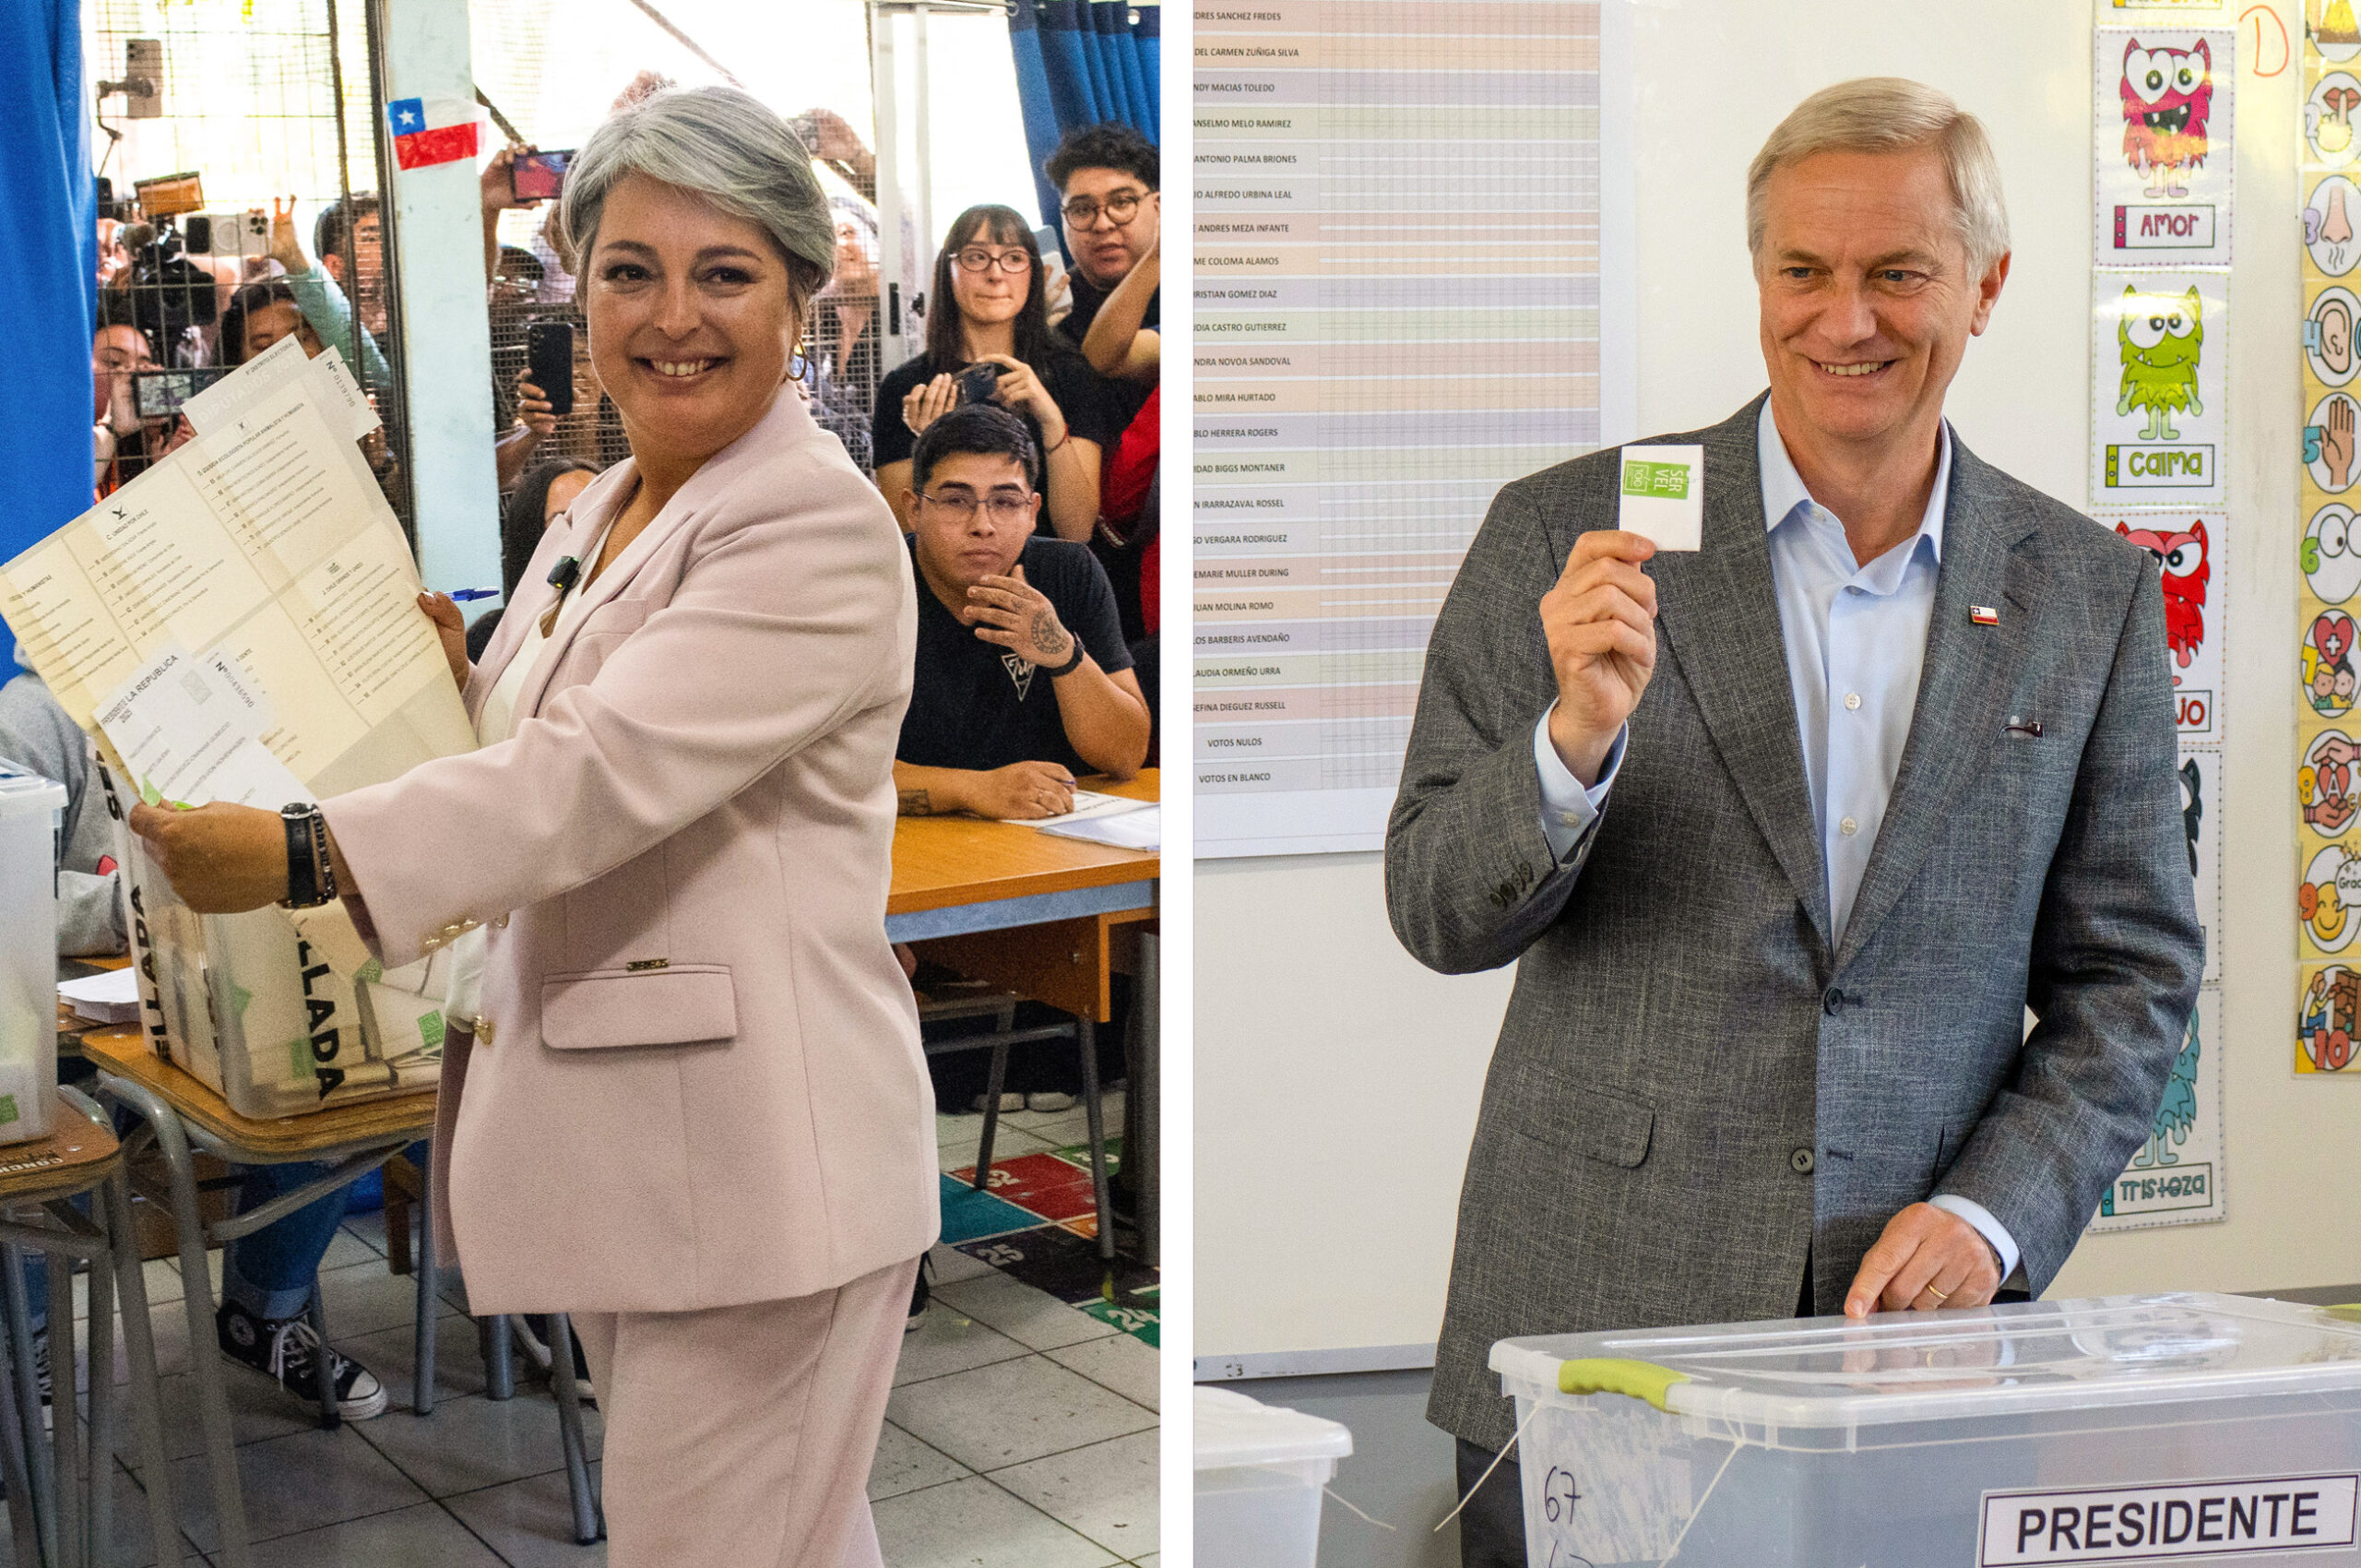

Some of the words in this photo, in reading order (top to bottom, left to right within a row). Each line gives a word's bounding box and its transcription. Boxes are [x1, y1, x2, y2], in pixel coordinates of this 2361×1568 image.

[1216, 12, 1252, 20] SANCHEZ
[1253, 12, 1282, 20] FREDES
[1194, 48, 1208, 56] DEL
[1210, 48, 1244, 56] CARMEN
[1246, 47, 1275, 56] ZUÑIGA
[1277, 49, 1299, 57] SILVA
[1211, 84, 1242, 92] MACIAS
[1244, 84, 1275, 92] TOLEDO
[1231, 120, 1254, 128] MELO
[1256, 120, 1291, 128] RAMIREZ
[1194, 155, 1231, 163] ANTONIO
[1233, 155, 1262, 163] PALMA
[1264, 155, 1297, 163] BRIONES
[1204, 191, 1240, 199] ALFREDO
[1242, 191, 1273, 199] URBINA
[1275, 191, 1292, 199] LEAL
[1199, 224, 1230, 232] ANDRES
[1232, 224, 1254, 232] MEZA
[1256, 224, 1289, 232] INFANTE
[2303, 208, 2321, 246] 3
[1208, 257, 1243, 266] COLOMA
[1246, 257, 1279, 266] ALAMOS
[1228, 291, 1257, 299] GOMEZ
[1212, 324, 1242, 332] CASTRO
[1244, 324, 1287, 332] GUTIERREZ
[2303, 319, 2322, 358] 4
[1218, 358, 1248, 366] NOVOA
[1250, 357, 1291, 365] SANDOVAL
[1215, 394, 1236, 402] MIRA
[1238, 394, 1275, 402] HURTADO
[1248, 429, 1278, 437] ROGERS
[2303, 426, 2320, 464] 5
[1240, 464, 1285, 472] MONTANER
[2129, 451, 2202, 477] Calma
[1654, 469, 1669, 491] VEL
[1668, 469, 1684, 492] SER
[1202, 500, 1254, 508] IRARRAZAVAL
[1256, 500, 1285, 508] ROSSEL
[1204, 536, 1241, 544] VERGARA
[1243, 534, 1287, 542] RODRIGUEZ
[2300, 536, 2320, 576] 6
[1226, 570, 1257, 578] MULLER
[1259, 568, 1289, 577] DURING
[1216, 603, 1247, 612] MOLINA
[1249, 601, 1275, 611] ROMO
[1208, 636, 1245, 644] BARBERIS
[1246, 633, 1290, 643] AVENDAÑO
[136, 654, 179, 693] REPUBLICA
[1222, 666, 1258, 676] ORMEÑO
[1259, 667, 1281, 675] URRA
[1219, 703, 1252, 711] DIEGUEZ
[1254, 702, 1287, 710] RUSSELL
[1207, 739, 1234, 747] VOTOS
[1236, 738, 1263, 746] NULOS
[1199, 775, 1226, 783] VOTOS
[1228, 774, 1238, 782] EN
[1240, 773, 1271, 782] BLANCO
[2297, 766, 2317, 805] 8
[2298, 881, 2319, 921] 9
[2315, 1028, 2351, 1070] 10
[2119, 1174, 2205, 1202] Tristeza
[1544, 1465, 1583, 1526] 67
[2016, 1491, 2319, 1554] PRESIDENTE
